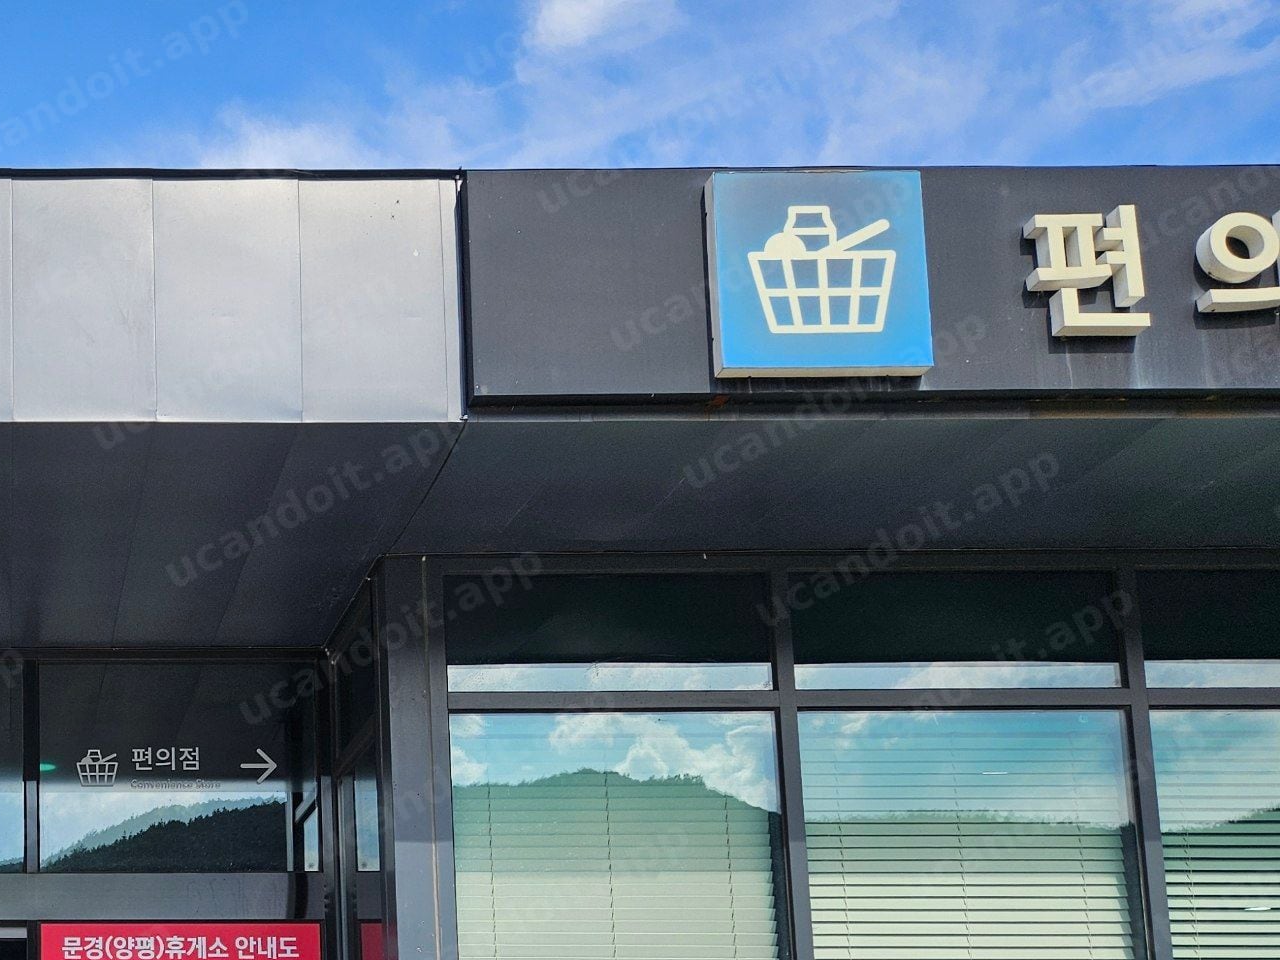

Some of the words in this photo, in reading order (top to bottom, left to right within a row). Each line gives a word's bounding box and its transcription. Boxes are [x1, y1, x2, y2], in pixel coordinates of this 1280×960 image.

[131, 746, 200, 771] 편의점
[130, 778, 193, 790] Convenience
[196, 777, 221, 790] Store
[61, 936, 229, 960] 문경(양평)휴게소
[235, 936, 300, 960] 안내도
